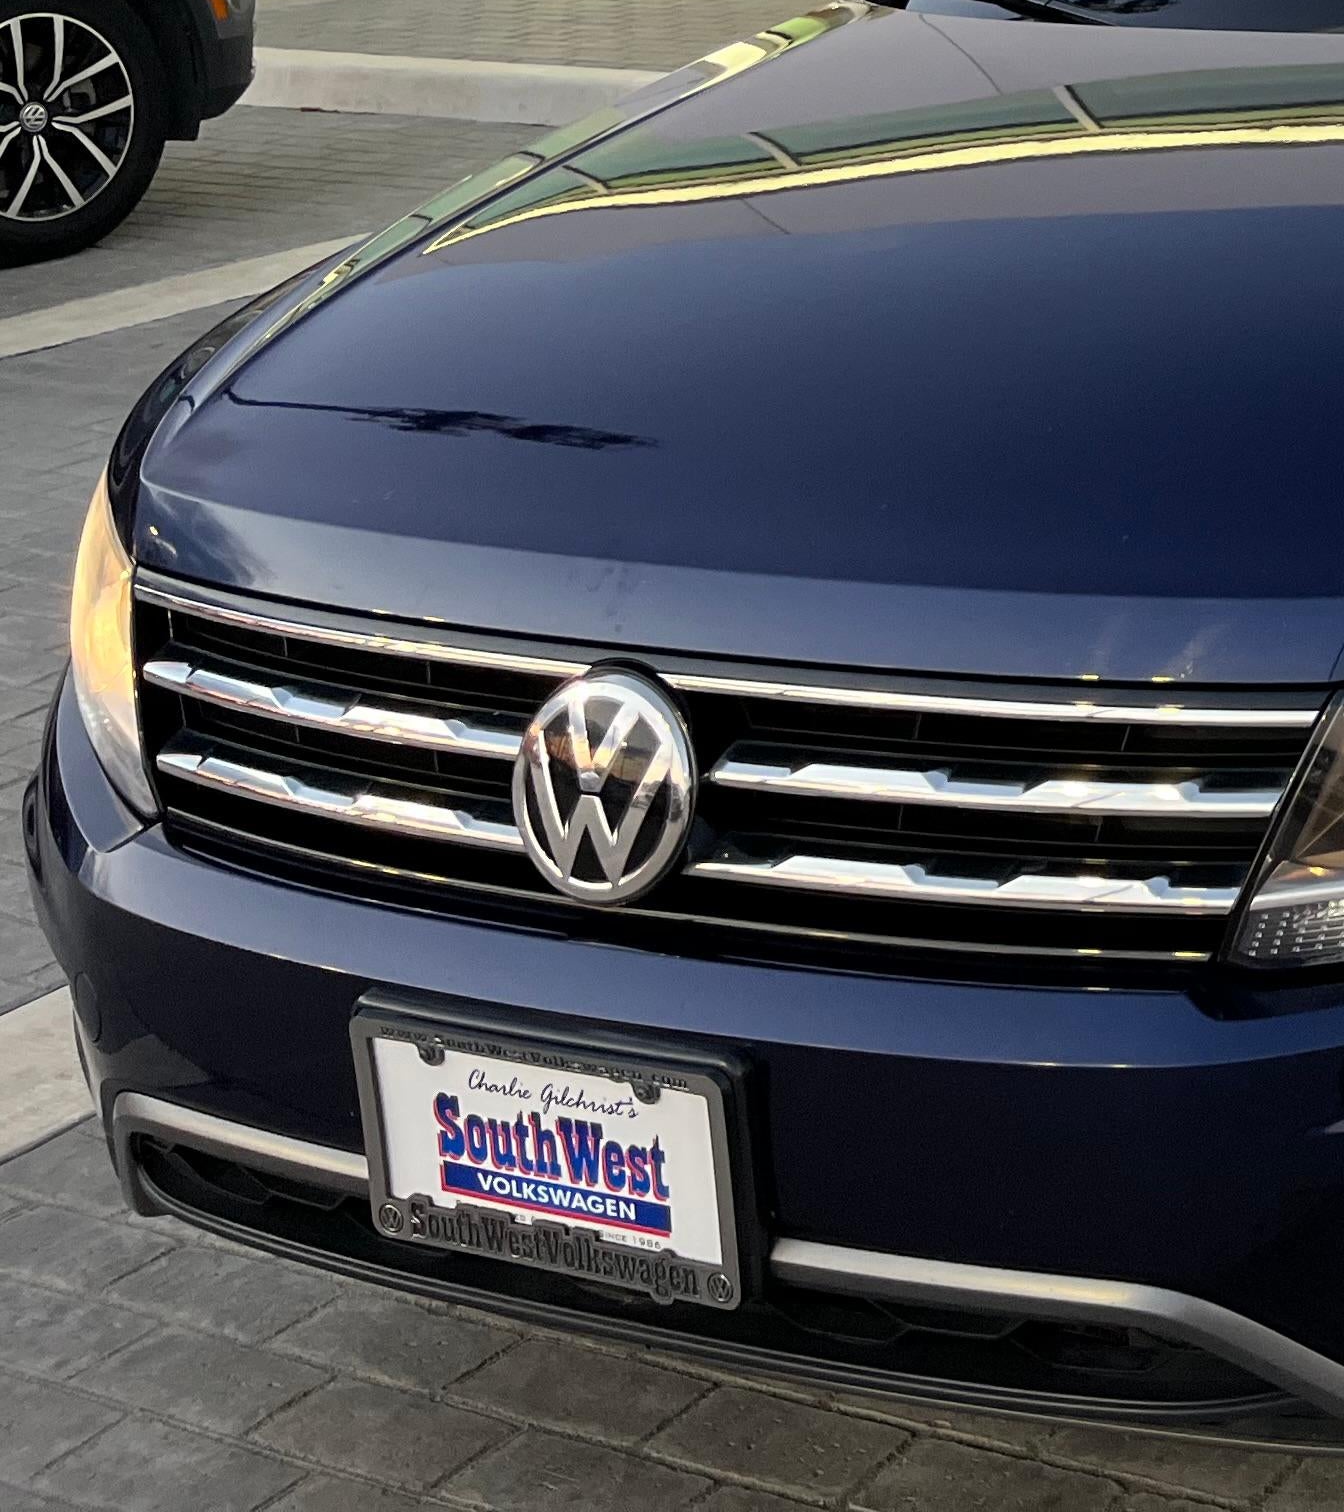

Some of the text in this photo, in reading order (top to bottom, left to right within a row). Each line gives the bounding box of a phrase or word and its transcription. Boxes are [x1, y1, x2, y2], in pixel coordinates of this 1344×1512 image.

[468, 1068, 639, 1119] Charlie Gilchrist's
[433, 1092, 670, 1201] SouthWest
[477, 1172, 637, 1221] VOLKSWAGEN
[410, 1200, 699, 1298] SouthWestVolkswagen
[600, 1230, 662, 1249] SINCE 1986
